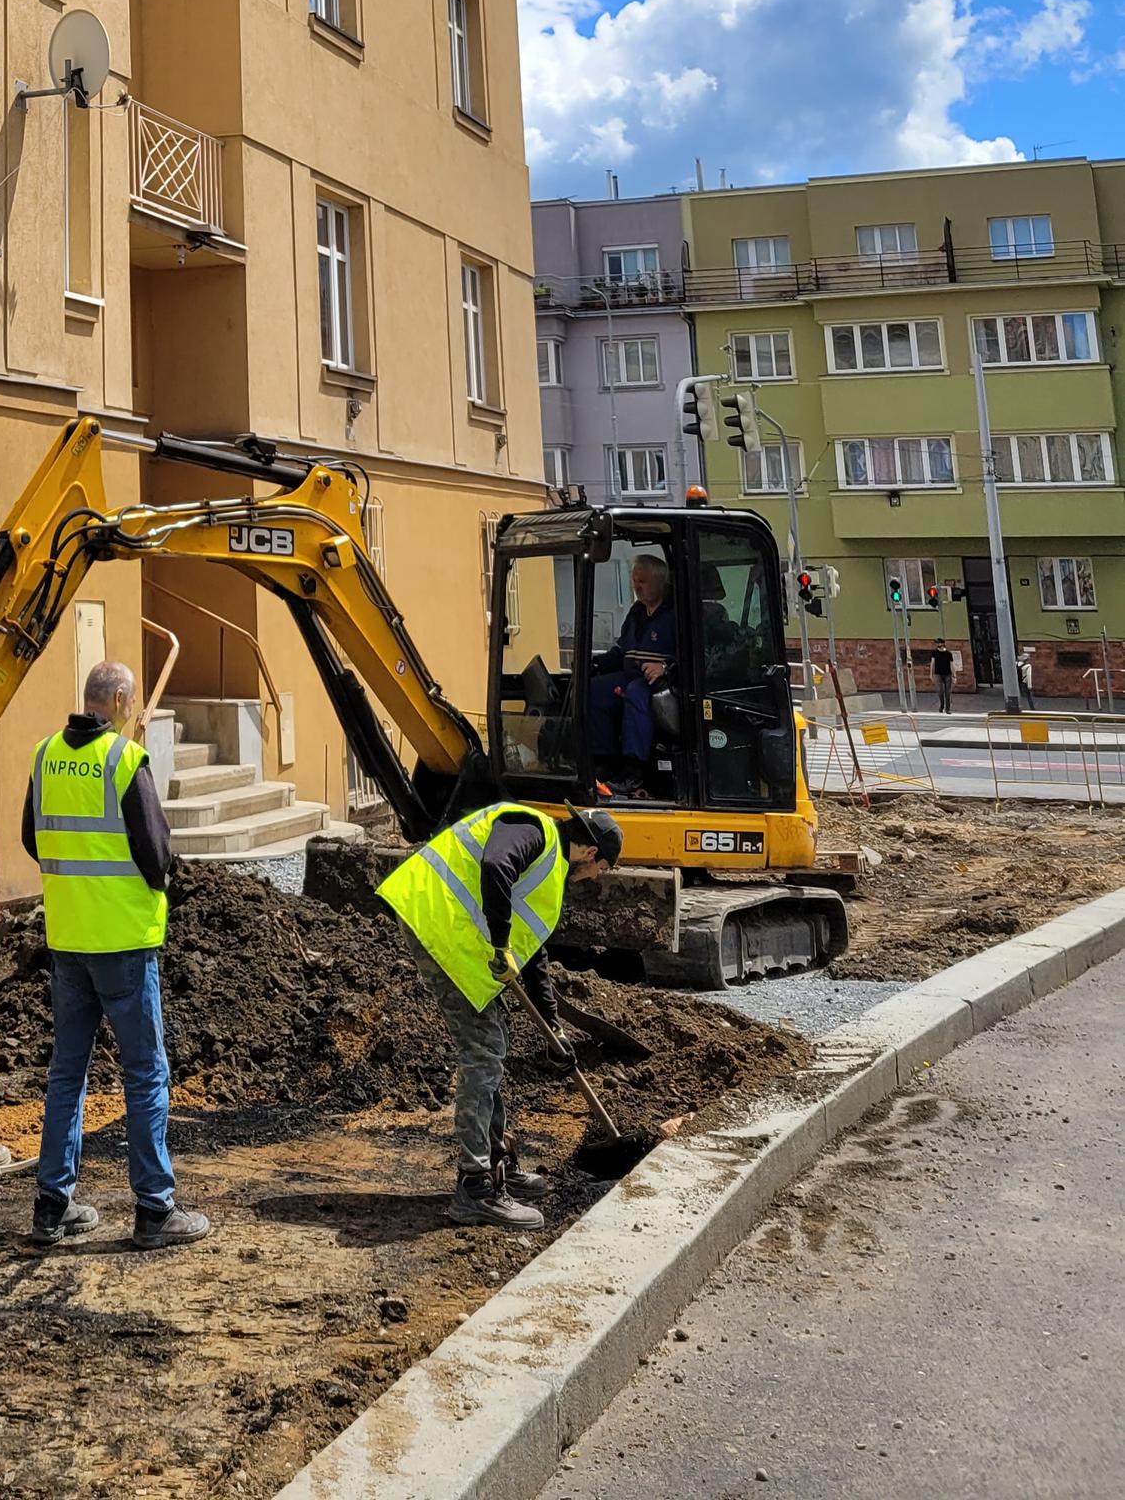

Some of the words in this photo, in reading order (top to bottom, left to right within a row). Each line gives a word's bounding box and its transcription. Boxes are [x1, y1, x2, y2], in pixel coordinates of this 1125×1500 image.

[230, 526, 293, 555] JCB
[45, 760, 102, 778] INPROS
[701, 832, 735, 852] 65
[742, 842, 763, 852] R-1
